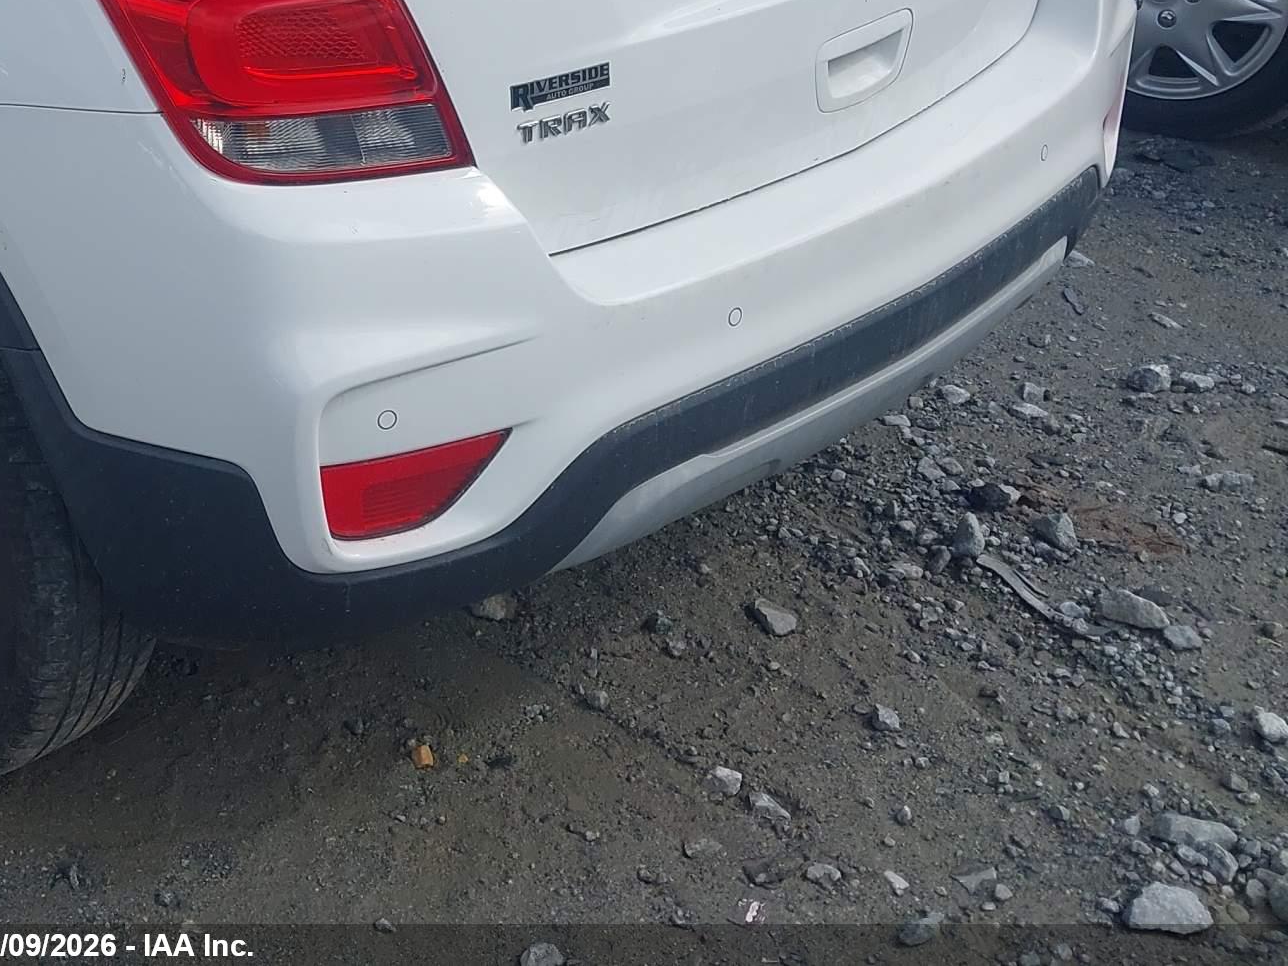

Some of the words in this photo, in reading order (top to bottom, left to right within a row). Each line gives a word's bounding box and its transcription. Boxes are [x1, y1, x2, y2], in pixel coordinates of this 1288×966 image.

[510, 62, 610, 112] RIVERSIDE
[546, 90, 567, 101] AUTO
[568, 83, 594, 97] GROUP
[516, 101, 611, 144] TRAX
